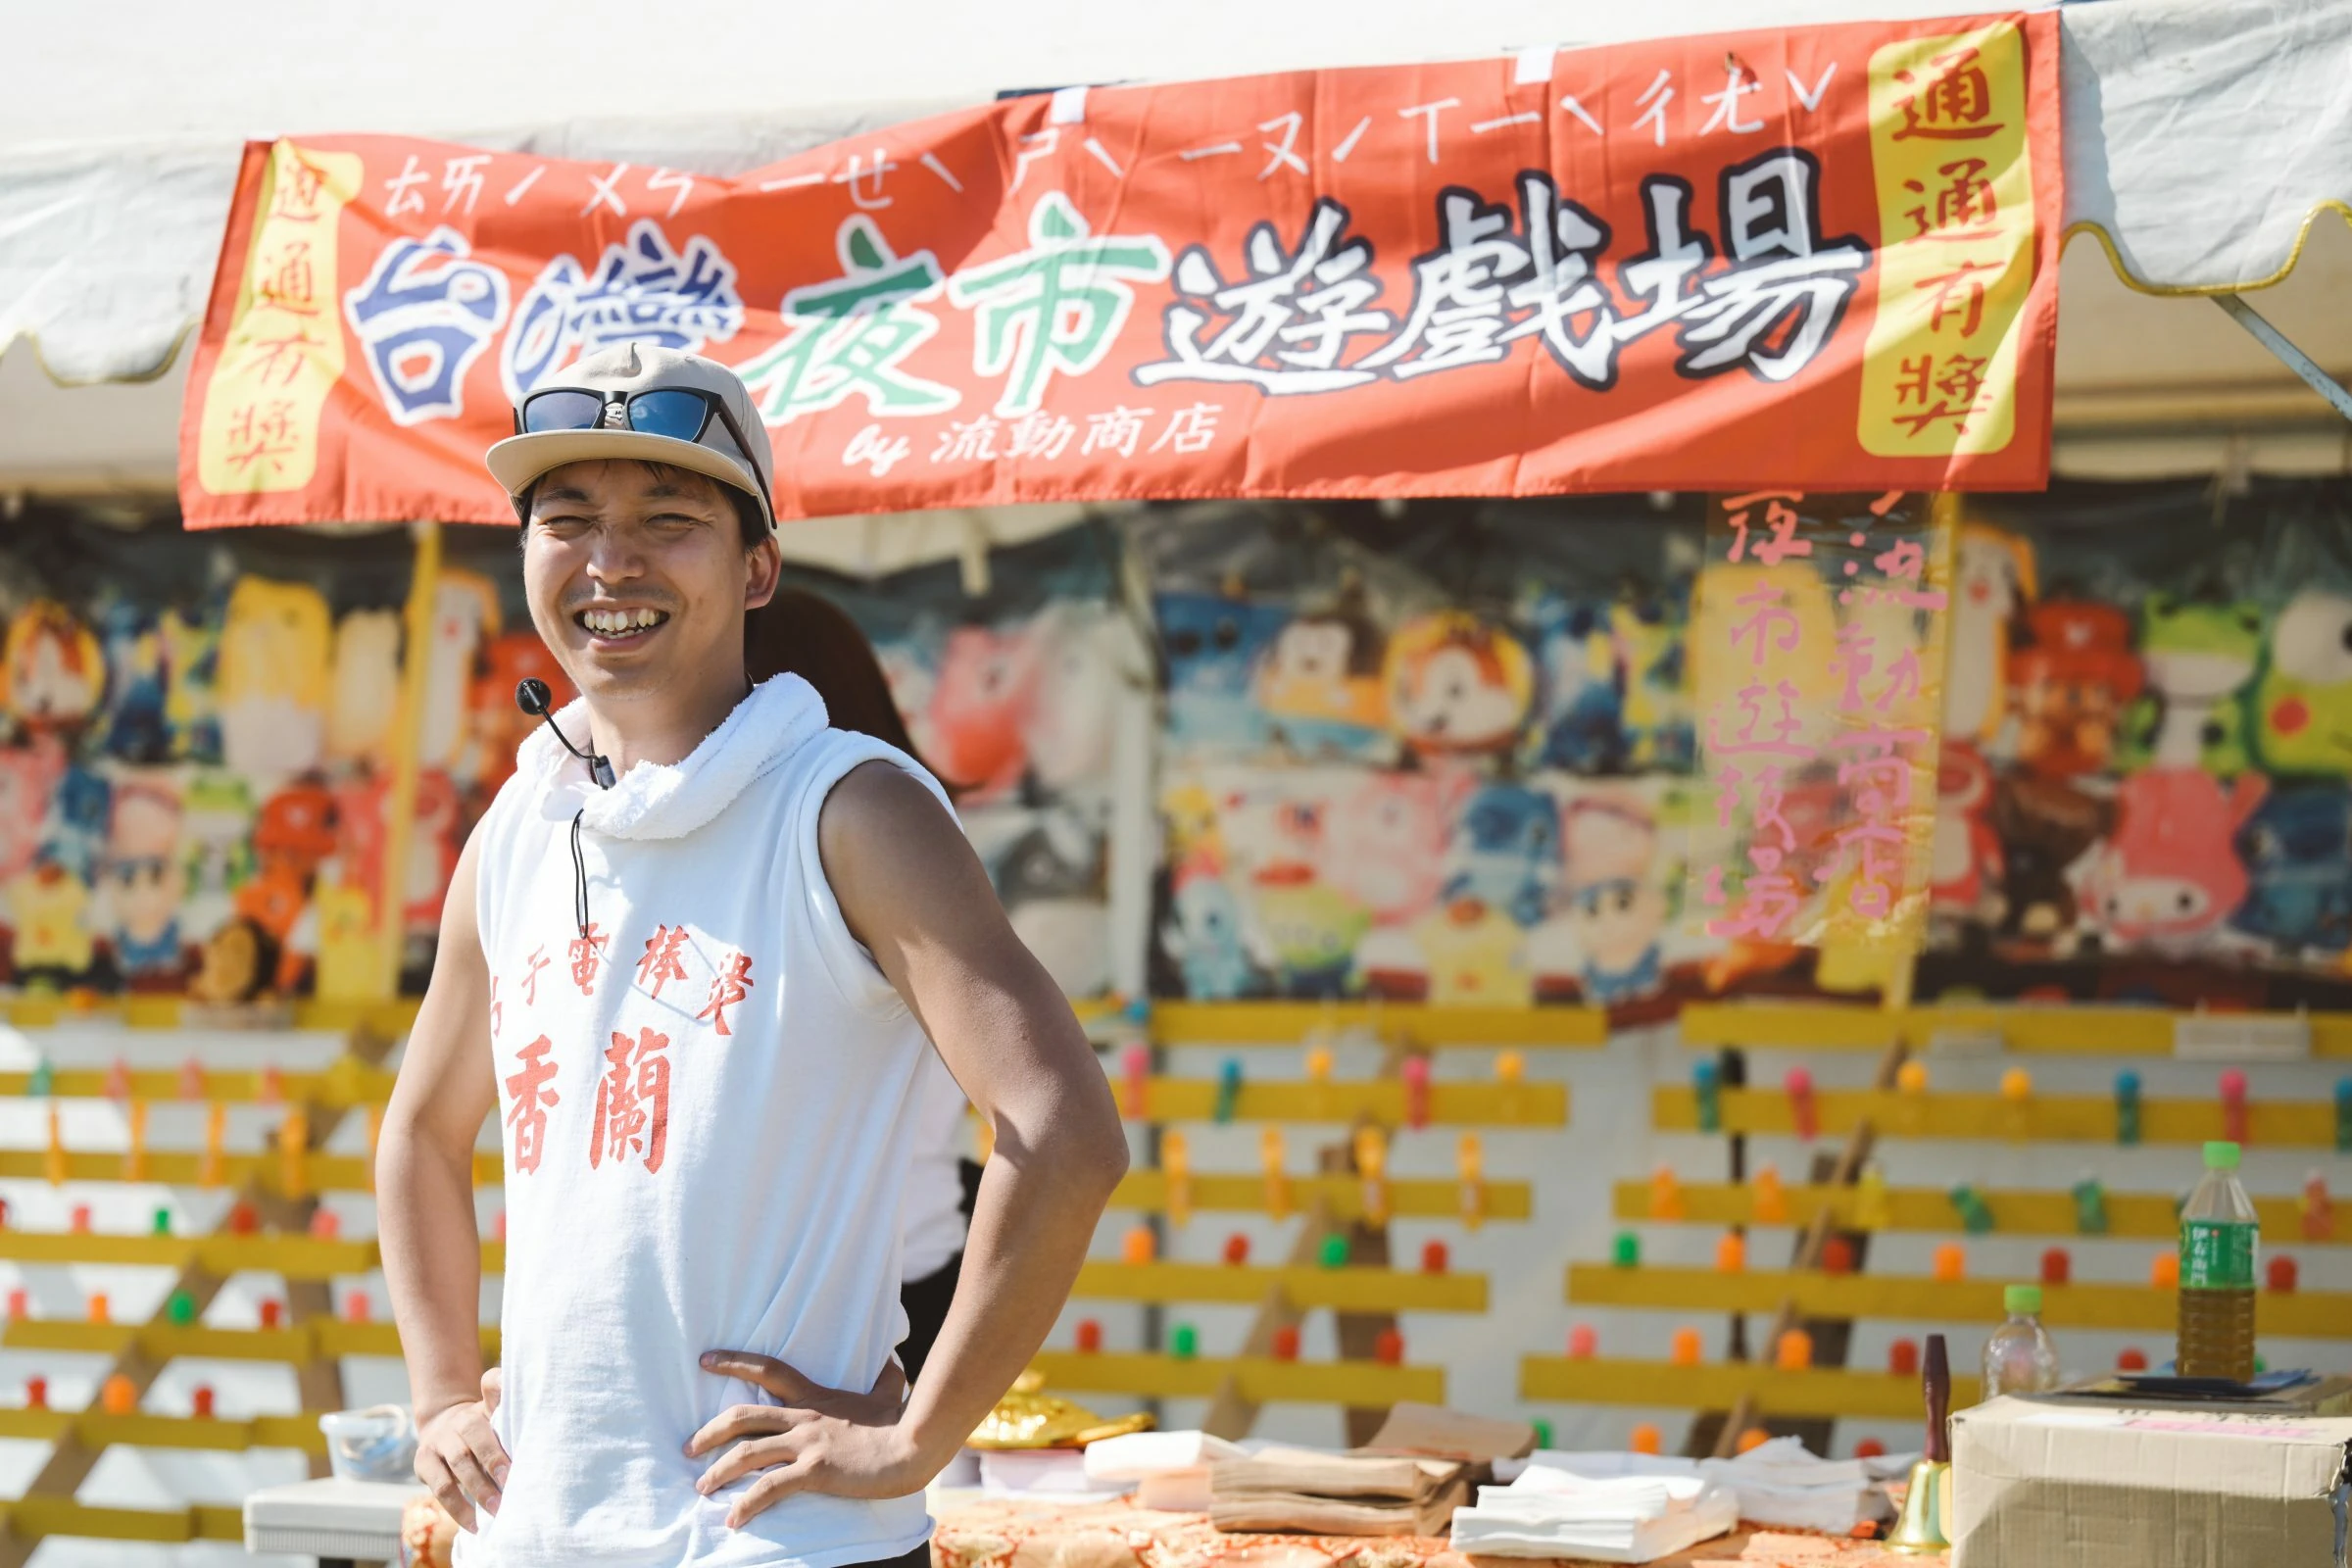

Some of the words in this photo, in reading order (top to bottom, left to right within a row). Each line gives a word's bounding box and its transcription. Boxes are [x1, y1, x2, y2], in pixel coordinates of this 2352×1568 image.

[1890, 46, 2005, 440] 通通有獎
[842, 423, 912, 477] by
[929, 403, 1224, 462] 流動商店
[505, 1026, 671, 1175] 香蘭
